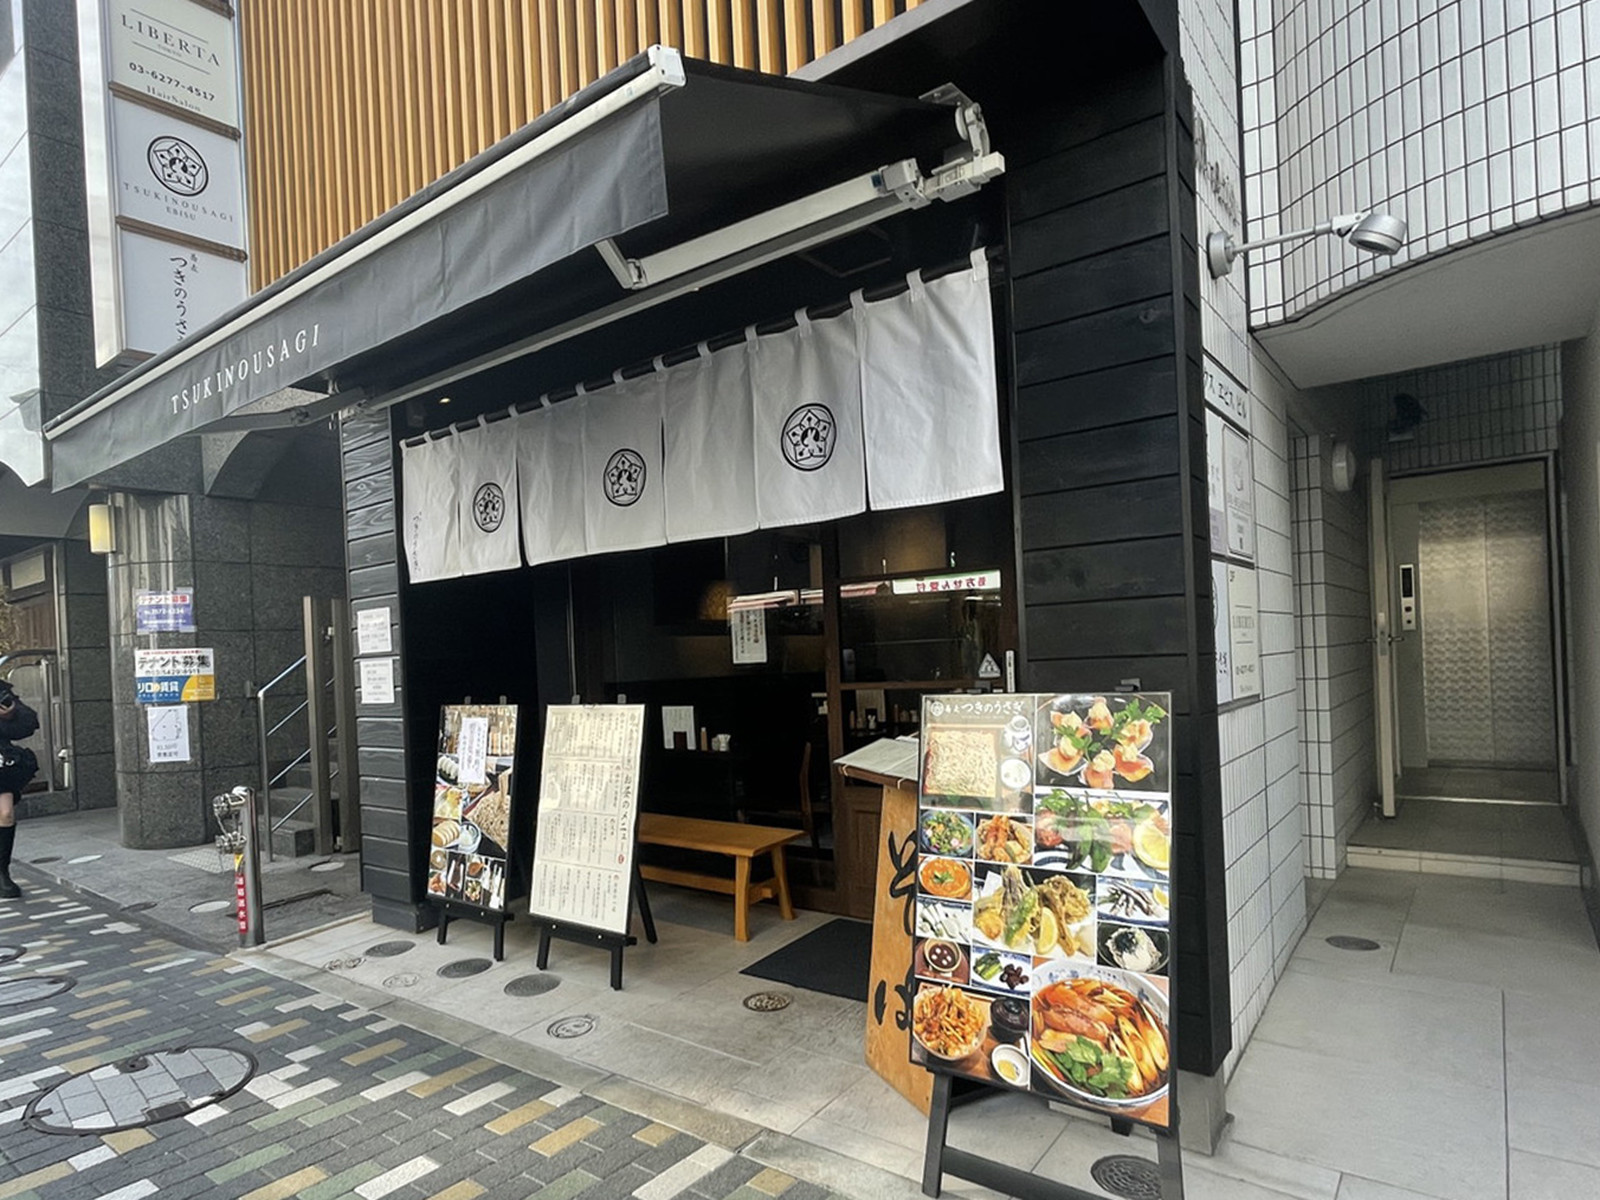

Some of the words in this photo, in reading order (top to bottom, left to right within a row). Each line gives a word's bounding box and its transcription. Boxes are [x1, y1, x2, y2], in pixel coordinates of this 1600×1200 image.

[122, 13, 220, 67] LIBERTA
[128, 62, 215, 102] 03-6277-4517
[123, 182, 235, 223] TSUKINOUSAGI
[166, 205, 197, 221] EBISU
[170, 323, 320, 415] TSUKINOUSAGI
[960, 701, 1025, 715] つきのうさぎ
